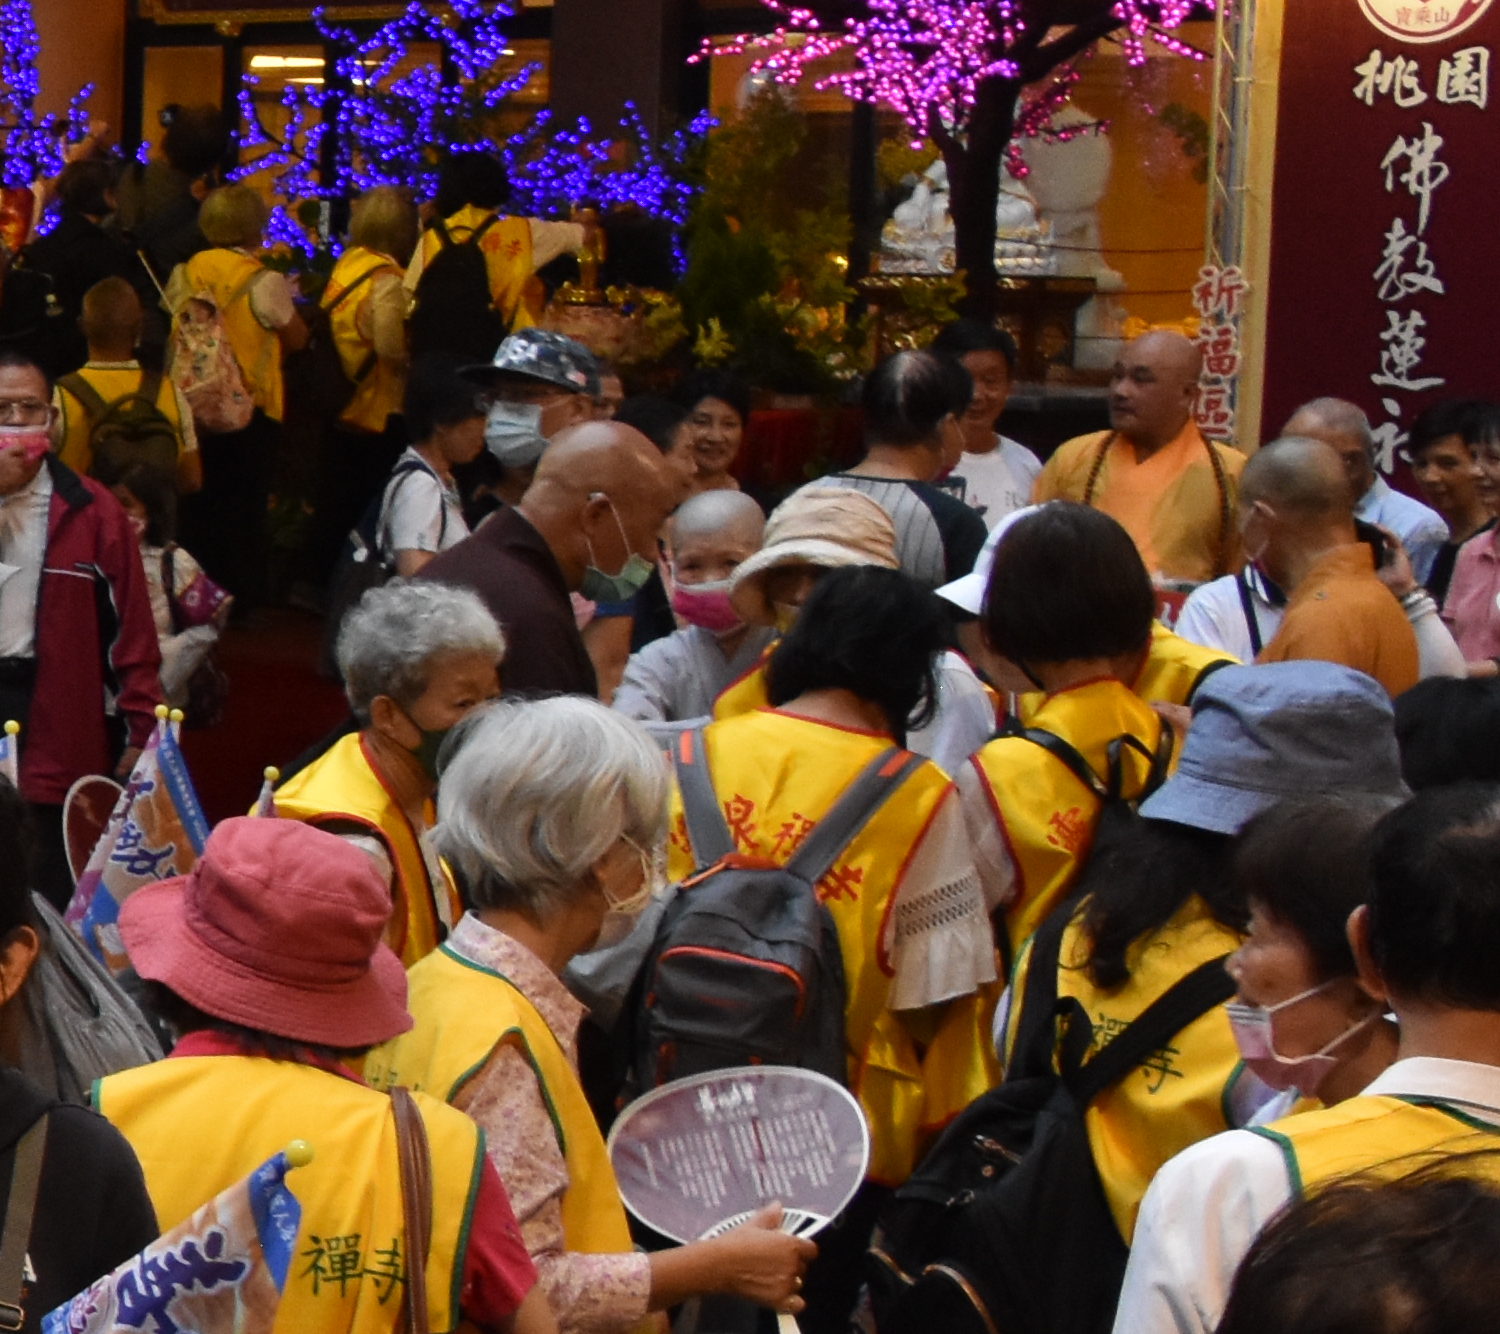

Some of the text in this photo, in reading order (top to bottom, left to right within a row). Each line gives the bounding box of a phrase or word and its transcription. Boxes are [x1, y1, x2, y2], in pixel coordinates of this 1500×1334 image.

[1353, 49, 1489, 109] 桃園
[1192, 265, 1249, 437] 祈福區
